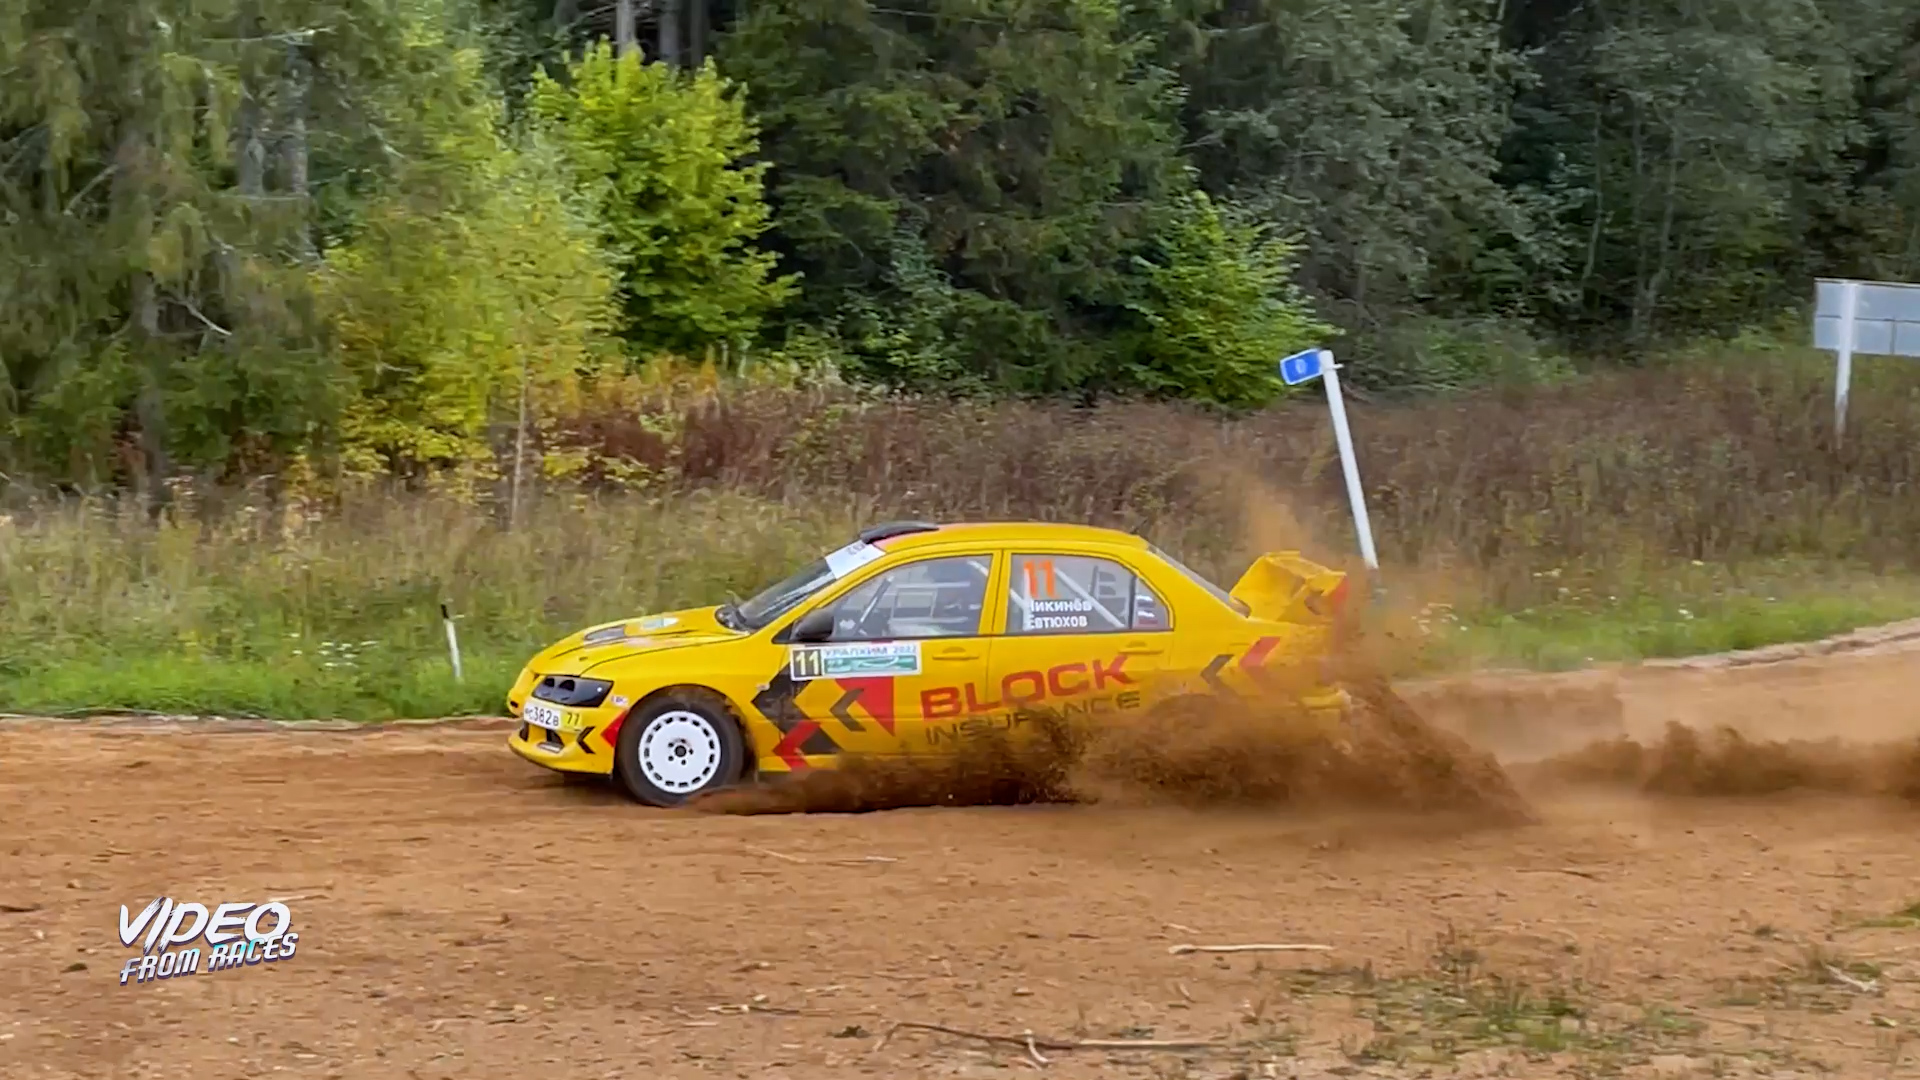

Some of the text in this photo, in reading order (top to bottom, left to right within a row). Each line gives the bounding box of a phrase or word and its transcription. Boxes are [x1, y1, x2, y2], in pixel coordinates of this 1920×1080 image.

[1024, 559, 1056, 598] 11
[795, 650, 820, 676] 11
[920, 654, 1134, 720] BLOCK
[566, 711, 580, 726] 77
